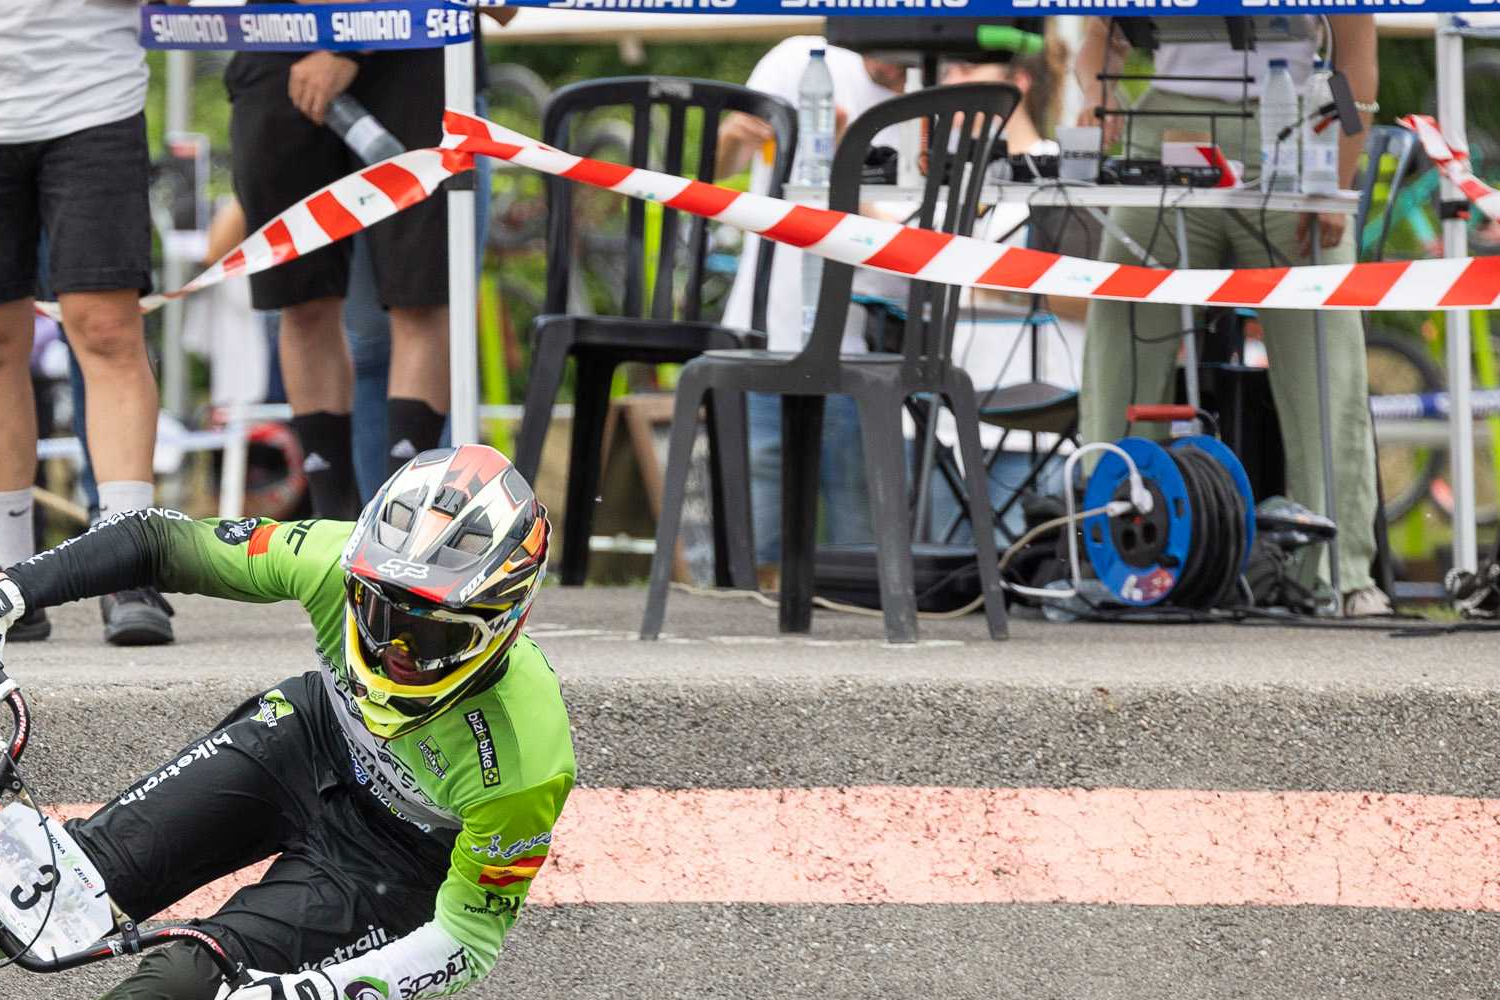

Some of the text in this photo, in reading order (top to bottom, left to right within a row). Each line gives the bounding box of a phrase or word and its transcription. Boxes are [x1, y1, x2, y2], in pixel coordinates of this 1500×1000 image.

[150, 14, 227, 42] SHIMANO
[240, 13, 318, 42] SHIMANO
[331, 9, 411, 41] SHIMANO
[459, 568, 488, 602] FOX
[10, 864, 61, 911] 3
[73, 866, 94, 889] ZERO
